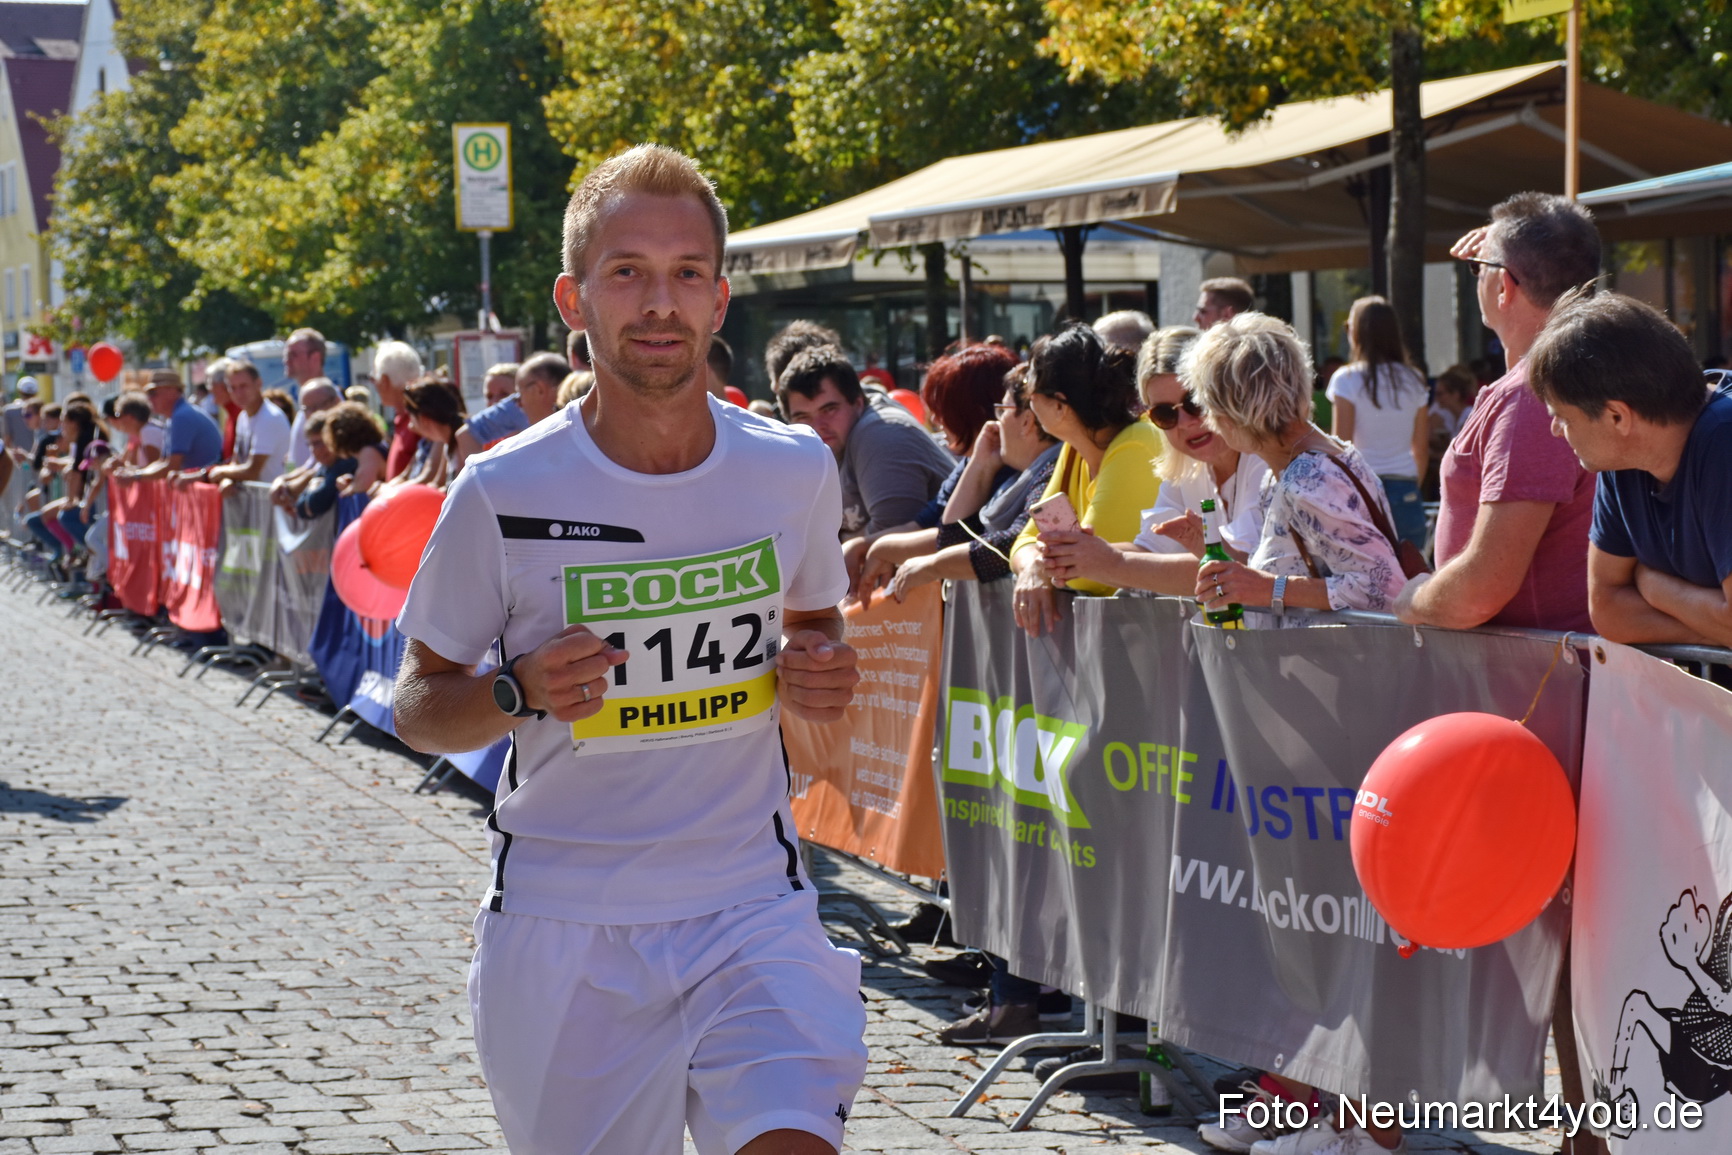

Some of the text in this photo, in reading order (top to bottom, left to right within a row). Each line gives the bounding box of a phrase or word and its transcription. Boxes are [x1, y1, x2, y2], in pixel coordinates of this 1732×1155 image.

[566, 525, 601, 537] JAKO
[586, 557, 760, 610] BOCK
[882, 620, 922, 635] Partner
[602, 612, 764, 687] 1142
[620, 691, 749, 729] PHILIPP
